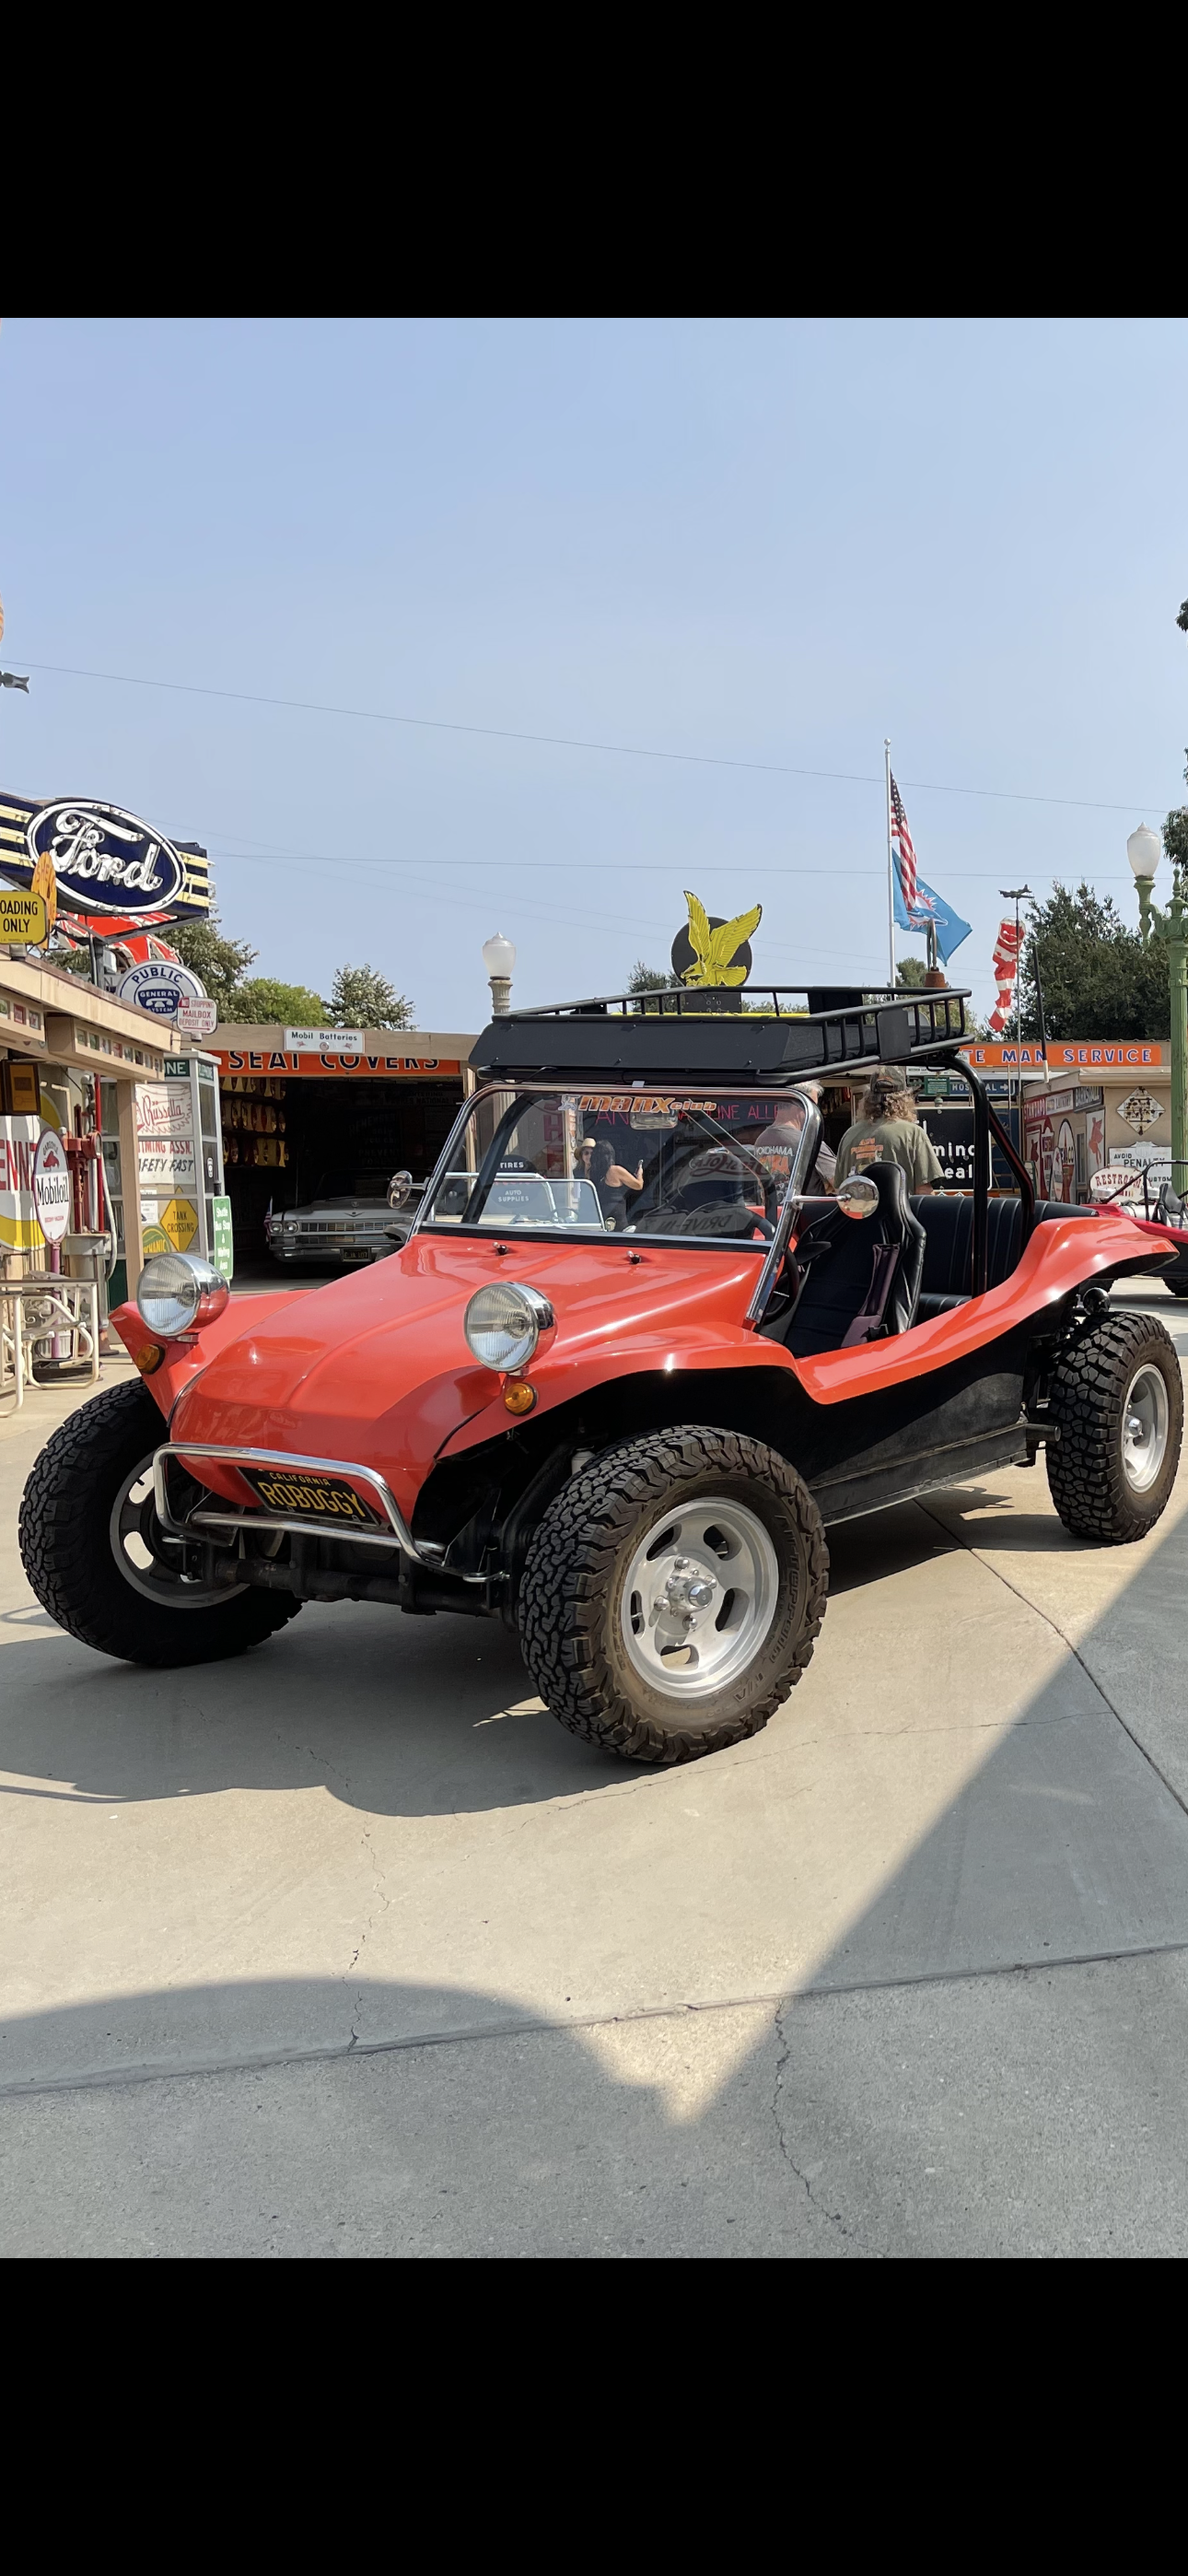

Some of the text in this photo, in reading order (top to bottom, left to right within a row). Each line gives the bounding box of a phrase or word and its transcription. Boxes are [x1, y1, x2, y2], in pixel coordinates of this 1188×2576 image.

[49, 809, 164, 892] Ford
[3, 918, 30, 933] ONLY
[132, 966, 183, 984] PUBLIC
[191, 1000, 215, 1009] STOPPING
[182, 1010, 212, 1019] MAILBOX
[201, 1020, 215, 1028] ONLY
[291, 1030, 358, 1041] Mobil Batteries
[229, 1051, 440, 1071] SEAT COVERS
[1002, 1049, 1045, 1063] MAN
[1063, 1048, 1152, 1063] SERVICE
[951, 1083, 997, 1092] HOSAL
[670, 1100, 717, 1111] club
[169, 1158, 194, 1173] FAST
[37, 1175, 70, 1206] Mobiloil
[172, 1211, 187, 1221] TANK
[167, 1222, 195, 1234] CROSSING
[269, 1472, 332, 1486] CALIFORNIA
